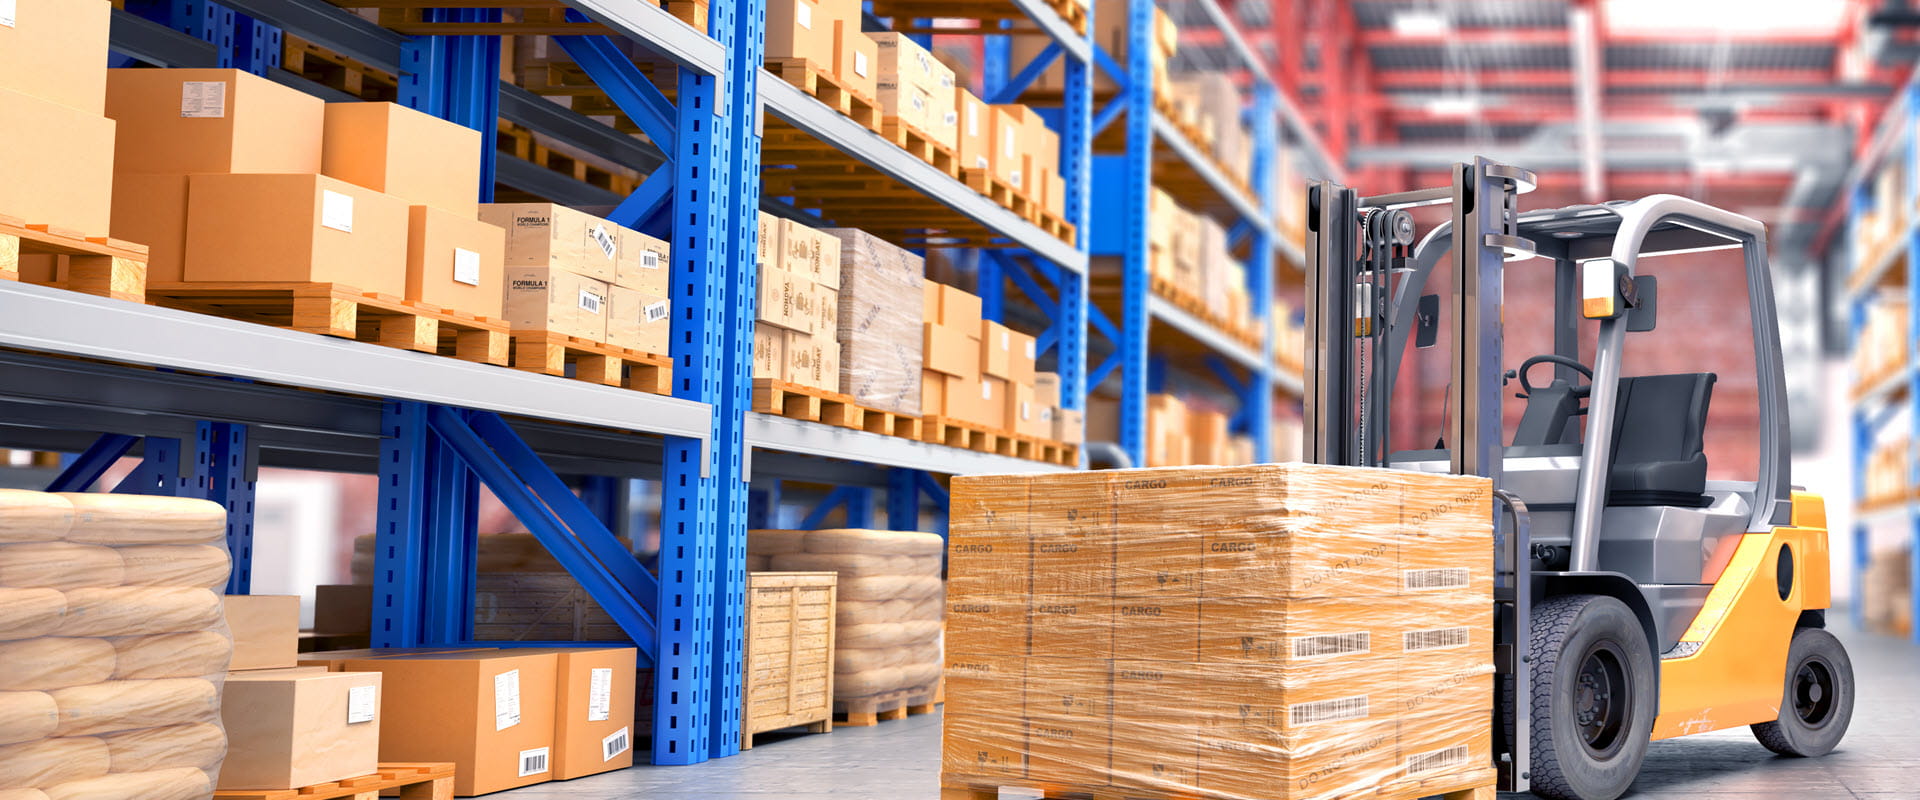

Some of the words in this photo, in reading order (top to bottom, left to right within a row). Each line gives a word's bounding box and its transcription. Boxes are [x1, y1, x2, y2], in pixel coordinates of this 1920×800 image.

[516, 216, 546, 224] FORMULA
[1125, 479, 1167, 490] CARGO
[1210, 477, 1253, 488] CARGO
[1411, 511, 1429, 526] DO
[1431, 501, 1453, 517] NOT
[1455, 487, 1484, 505] DROP
[955, 544, 993, 553] CARGO
[1040, 544, 1078, 553] CARGO
[1211, 542, 1257, 552] CARGO
[1302, 573, 1323, 590] DO
[1326, 559, 1351, 579] NOT
[1355, 543, 1388, 567] DROP
[953, 604, 990, 613] CARGO
[1039, 605, 1077, 615] CARGO
[1121, 606, 1162, 617] CARGO
[1121, 670, 1164, 681] CARGO
[1035, 727, 1074, 739] CARGO
[1299, 772, 1319, 790] DO
